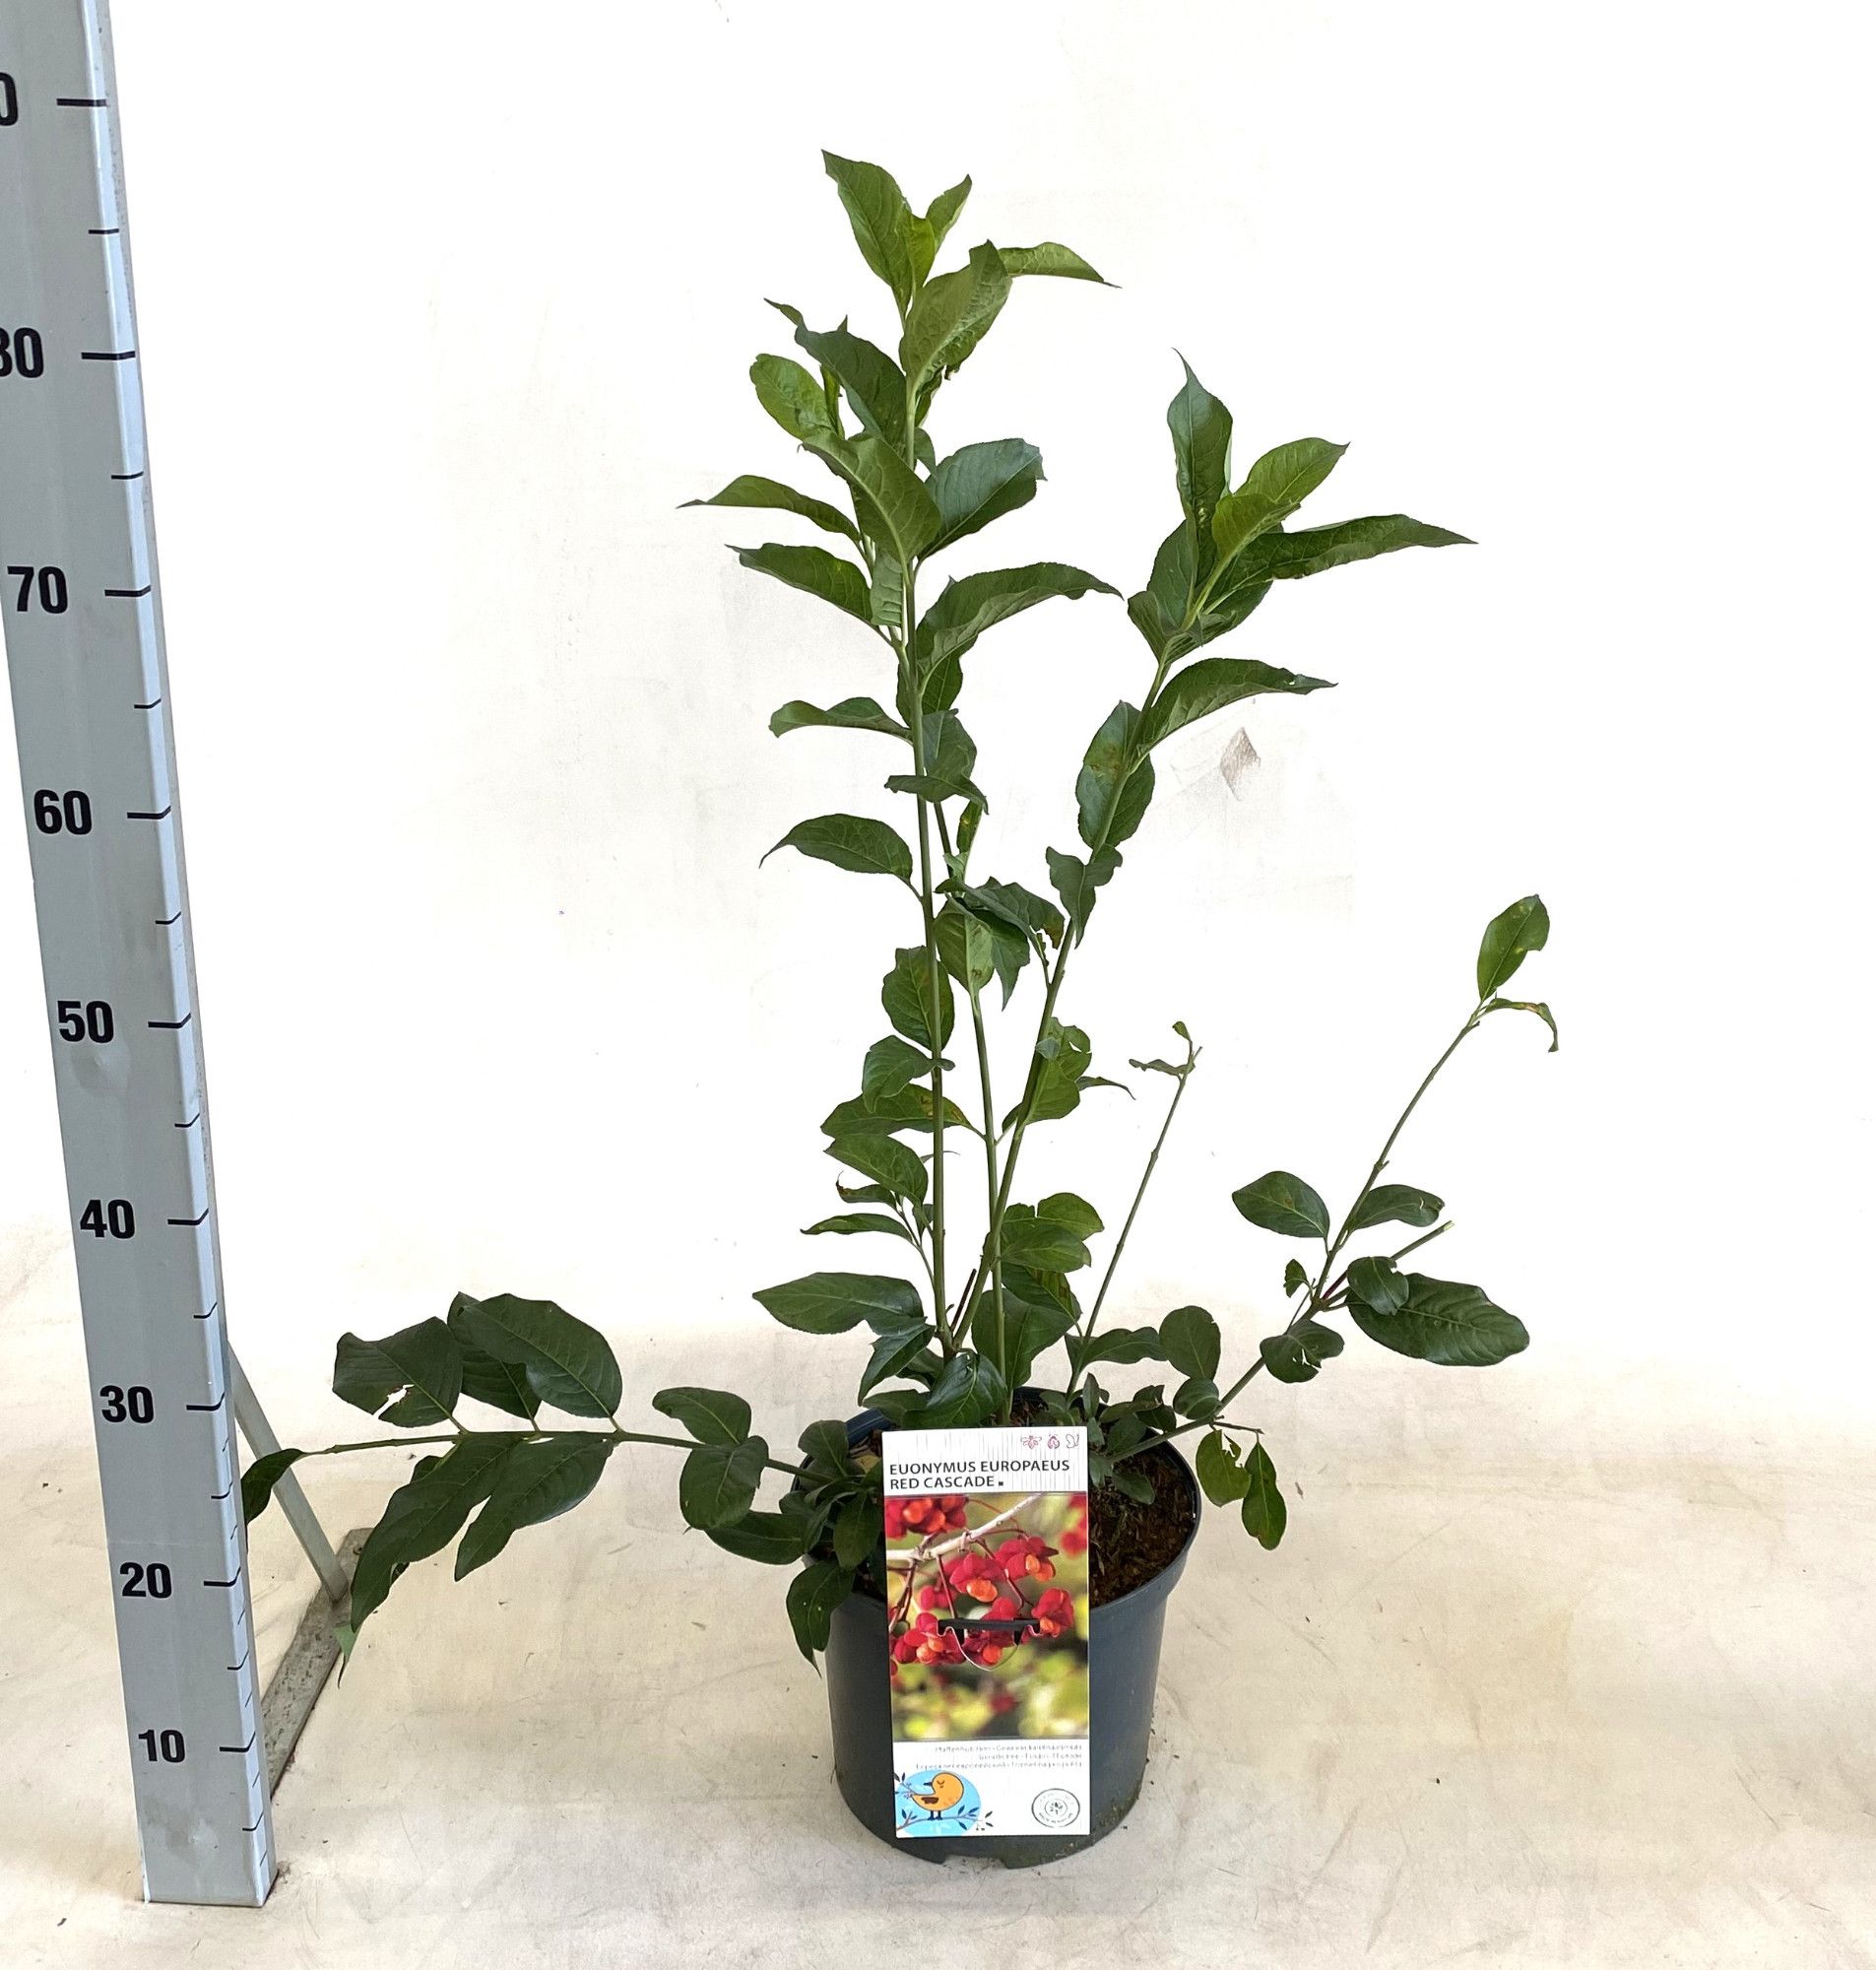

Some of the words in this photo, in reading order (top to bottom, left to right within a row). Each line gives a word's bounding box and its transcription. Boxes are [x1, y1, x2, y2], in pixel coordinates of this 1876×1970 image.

[6, 565, 68, 615] 70
[33, 789, 94, 835] 60
[57, 1000, 114, 1044] 50
[79, 1199, 136, 1238] 40
[99, 1384, 155, 1424] 30
[889, 1462, 976, 1476] EUONYMUS
[980, 1460, 1070, 1473] EUROPAEUS
[890, 1478, 920, 1490] RED
[924, 1476, 995, 1488] CASCADE
[119, 1561, 172, 1599] 20
[138, 1729, 186, 1763] 10
